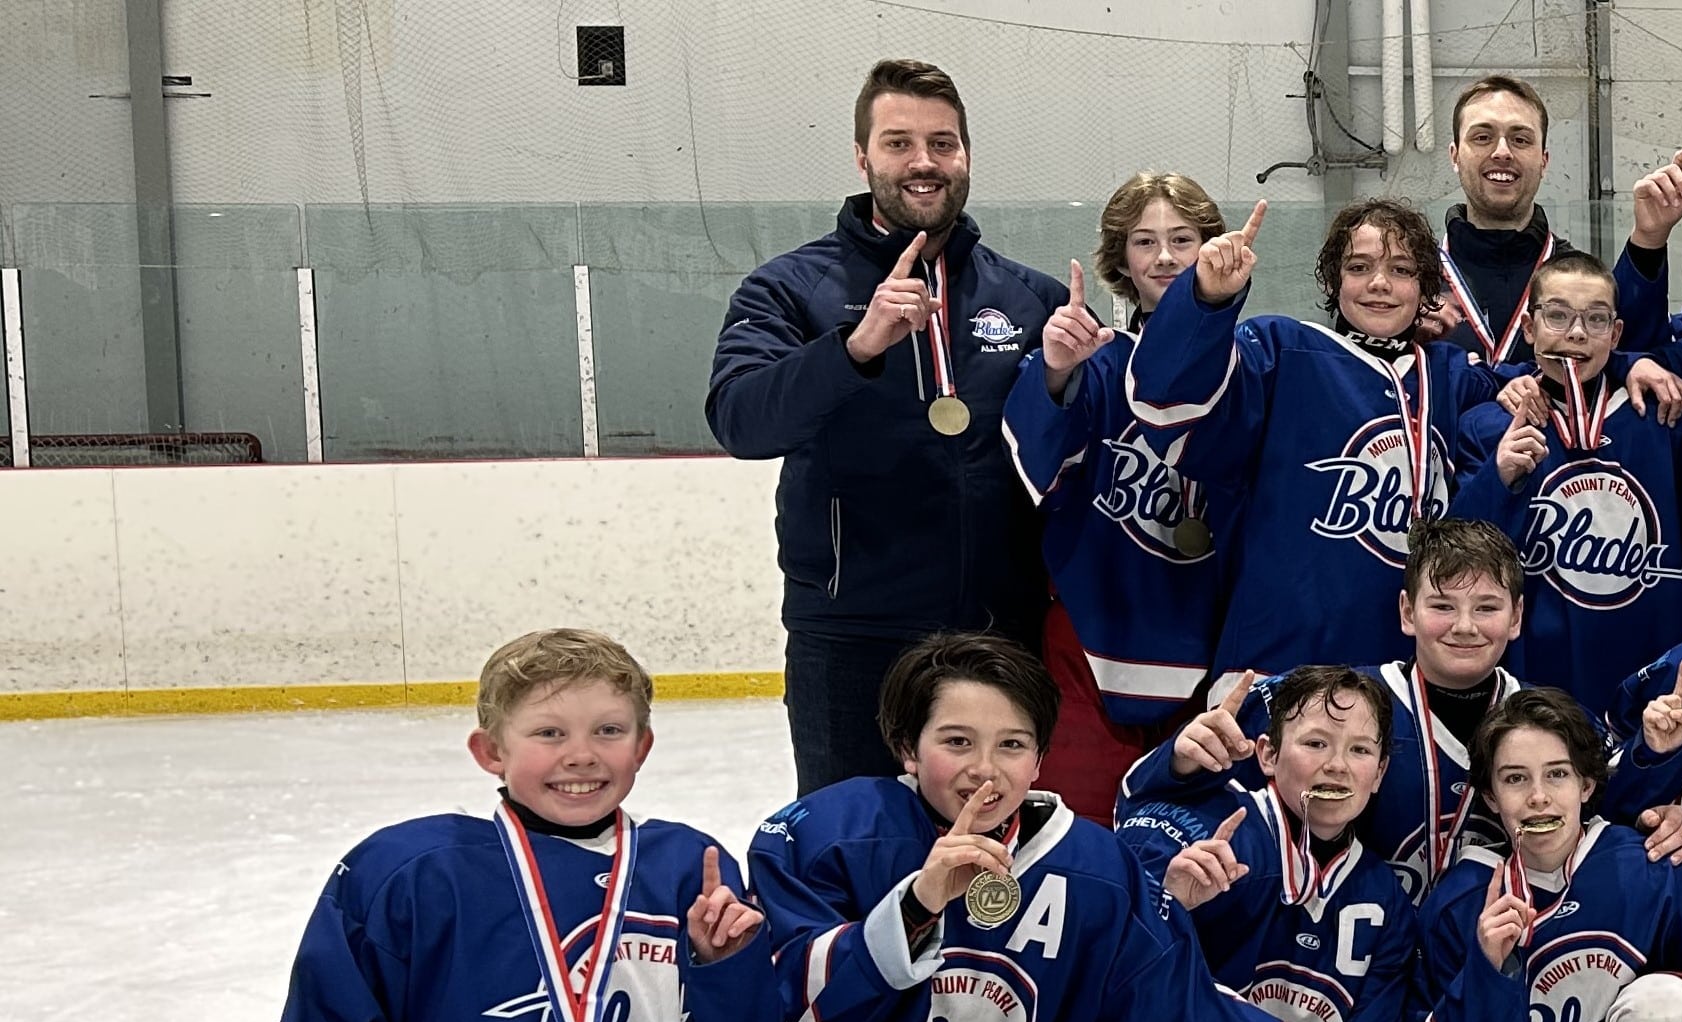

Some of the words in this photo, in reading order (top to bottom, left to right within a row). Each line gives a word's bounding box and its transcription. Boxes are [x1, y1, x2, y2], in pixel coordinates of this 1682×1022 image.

[969, 316, 1023, 338] Blades
[981, 344, 996, 353] ALL
[998, 343, 1020, 352] STAR
[1345, 330, 1407, 351] CCM
[1560, 478, 1605, 499] MOUNT
[1123, 817, 1190, 850] CHEVROLE
[1005, 874, 1067, 959] A
[1336, 903, 1385, 977] C
[639, 942, 678, 965] PEA
[1535, 957, 1581, 995] MOUNT
[1586, 953, 1624, 979] PEARL
[932, 976, 982, 995] OUNT
[981, 980, 1019, 1018] PEARL
[1251, 985, 1300, 1006] MOUNT
